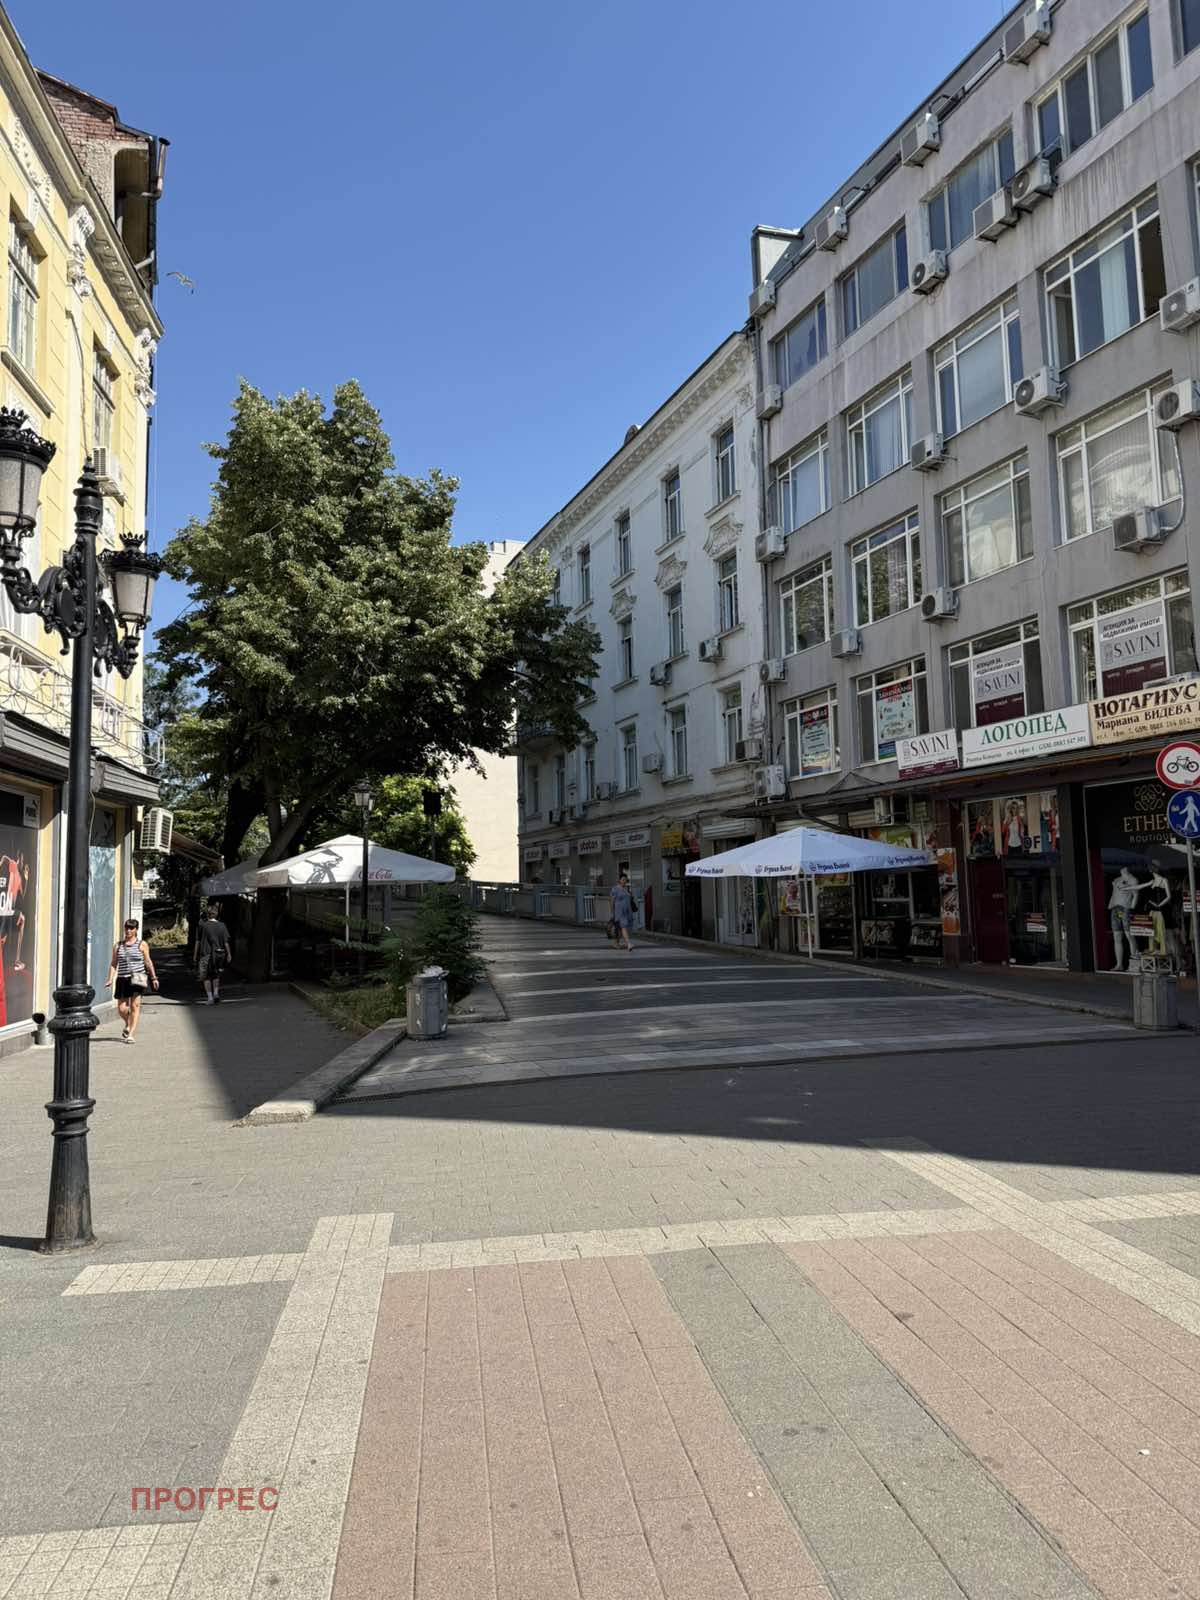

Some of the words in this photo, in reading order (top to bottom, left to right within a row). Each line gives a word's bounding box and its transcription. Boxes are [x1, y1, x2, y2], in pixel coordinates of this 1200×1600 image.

[1093, 682, 1198, 719] НОТАРИУС
[1144, 703, 1192, 721] ВИДЕВА
[981, 712, 1068, 745] ЛОГОПЕД
[1123, 813, 1169, 833] ETHE
